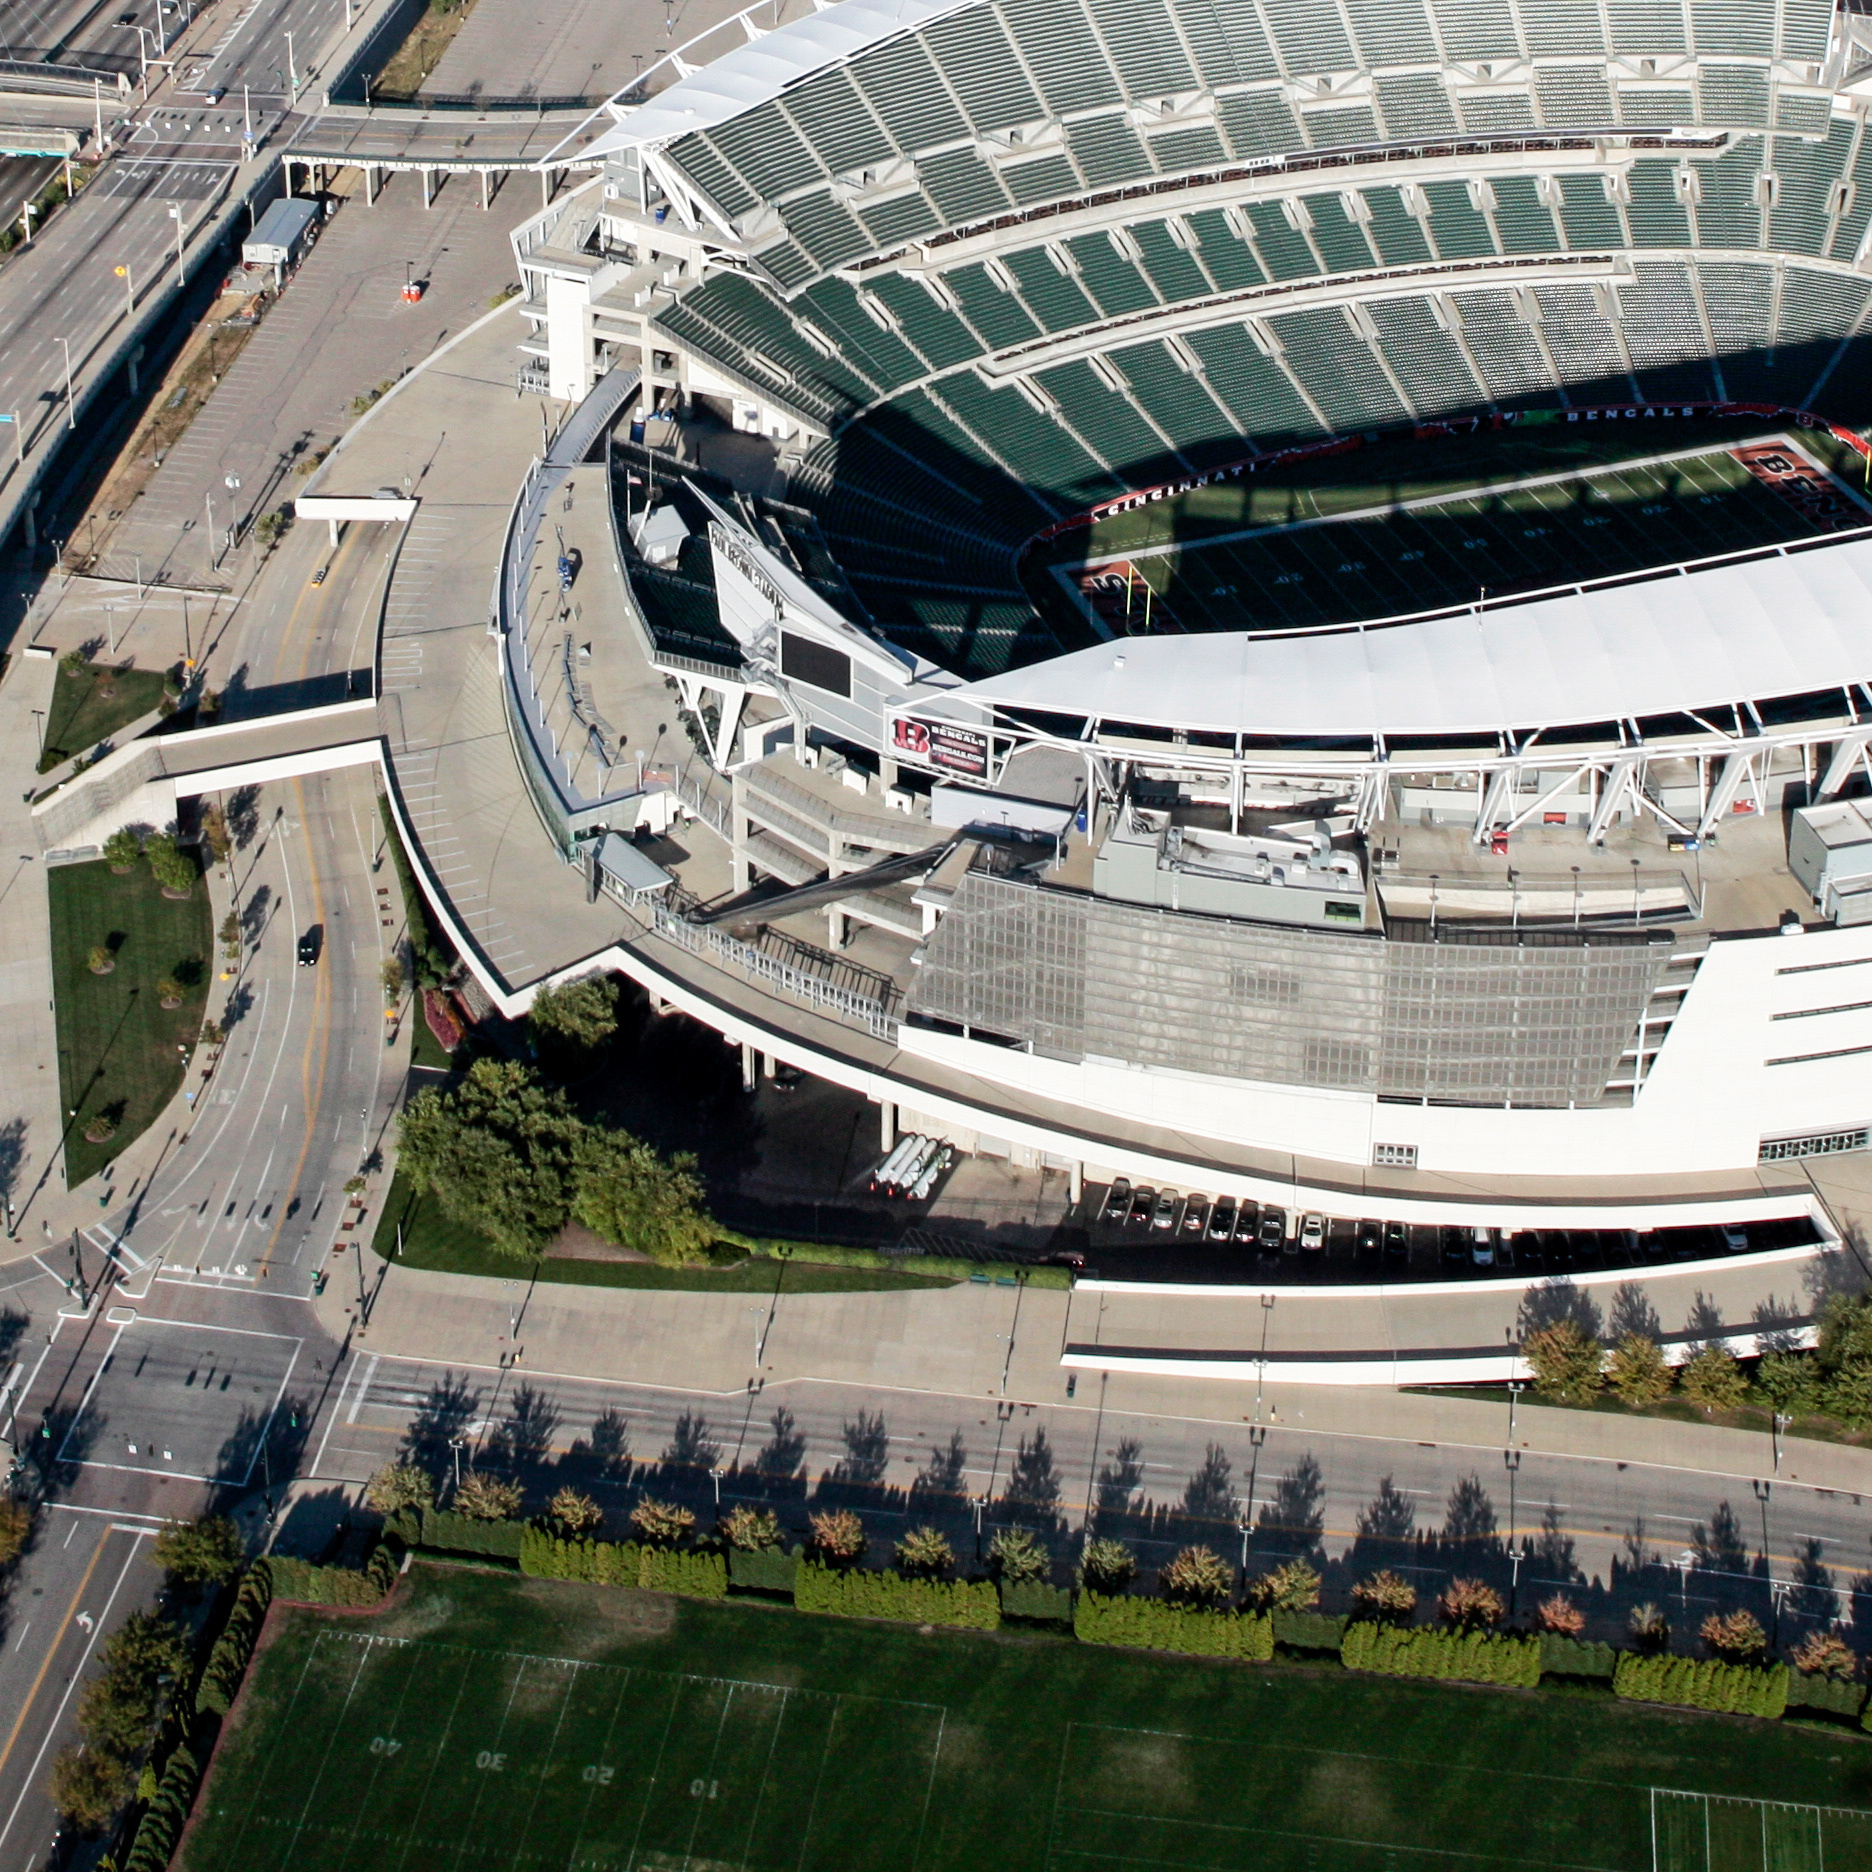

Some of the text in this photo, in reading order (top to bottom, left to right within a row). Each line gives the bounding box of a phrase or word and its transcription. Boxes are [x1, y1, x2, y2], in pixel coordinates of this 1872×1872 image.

[1567, 407, 1694, 421] BENGALS
[1107, 463, 1255, 516] CINCINNATI
[931, 725, 986, 747] BENGALS
